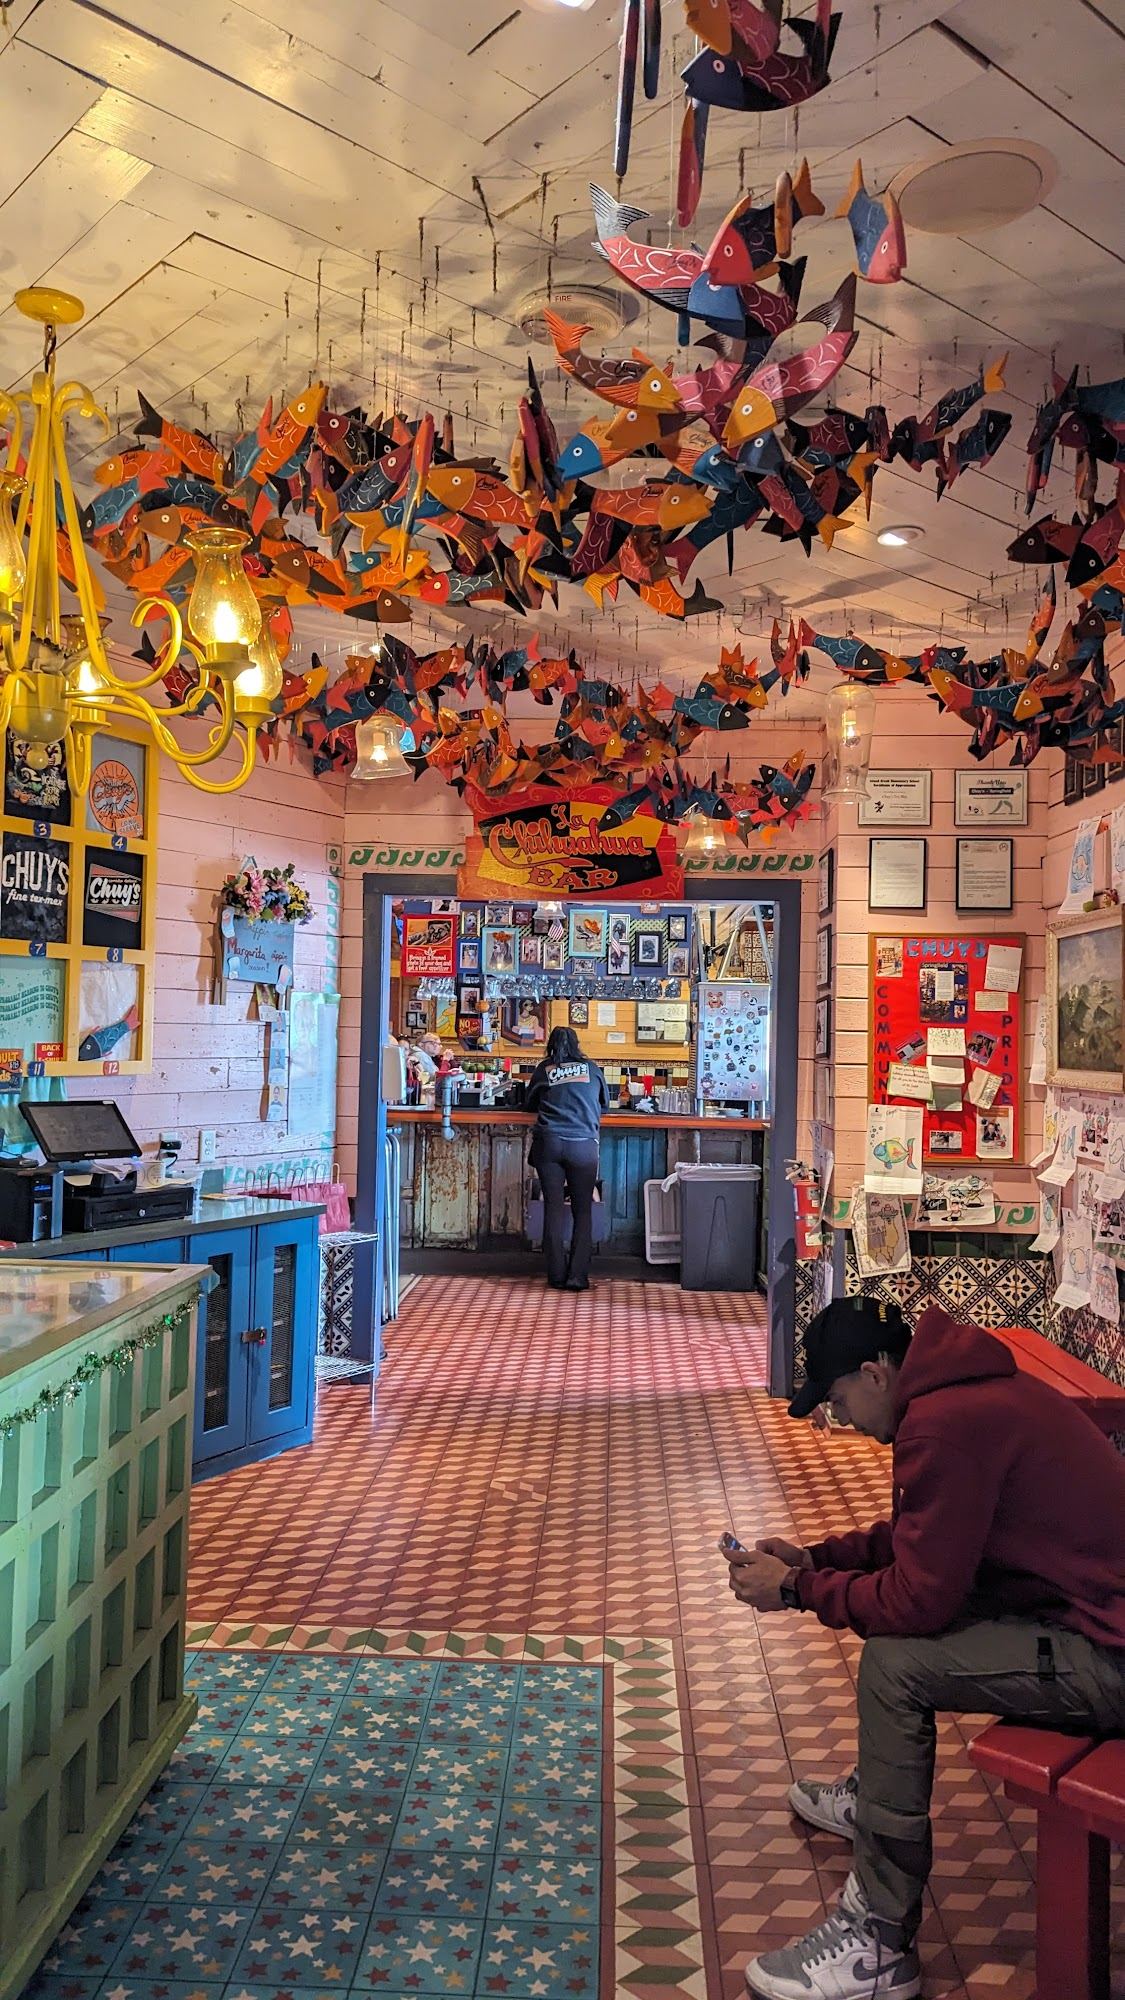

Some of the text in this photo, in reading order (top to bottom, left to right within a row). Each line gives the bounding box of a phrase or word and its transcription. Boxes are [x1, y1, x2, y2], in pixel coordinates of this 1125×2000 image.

[551, 804, 590, 830] La
[38, 823, 48, 836] 3
[115, 837, 124, 849] 4
[489, 817, 652, 868] Chihuahua
[2, 850, 69, 896] CHUY'S
[528, 868, 618, 890] BAR
[6, 888, 64, 907] fine tex-mex
[89, 877, 141, 907] Chuy's
[35, 943, 43, 954] 7
[112, 947, 119, 961] 8
[459, 1018, 470, 1028] NO
[877, 986, 892, 1105] COMMUNI
[0, 1052, 18, 1062] ULT
[33, 1062, 42, 1075] 11
[108, 1063, 118, 1073] 12
[549, 1064, 587, 1081] Chuy's
